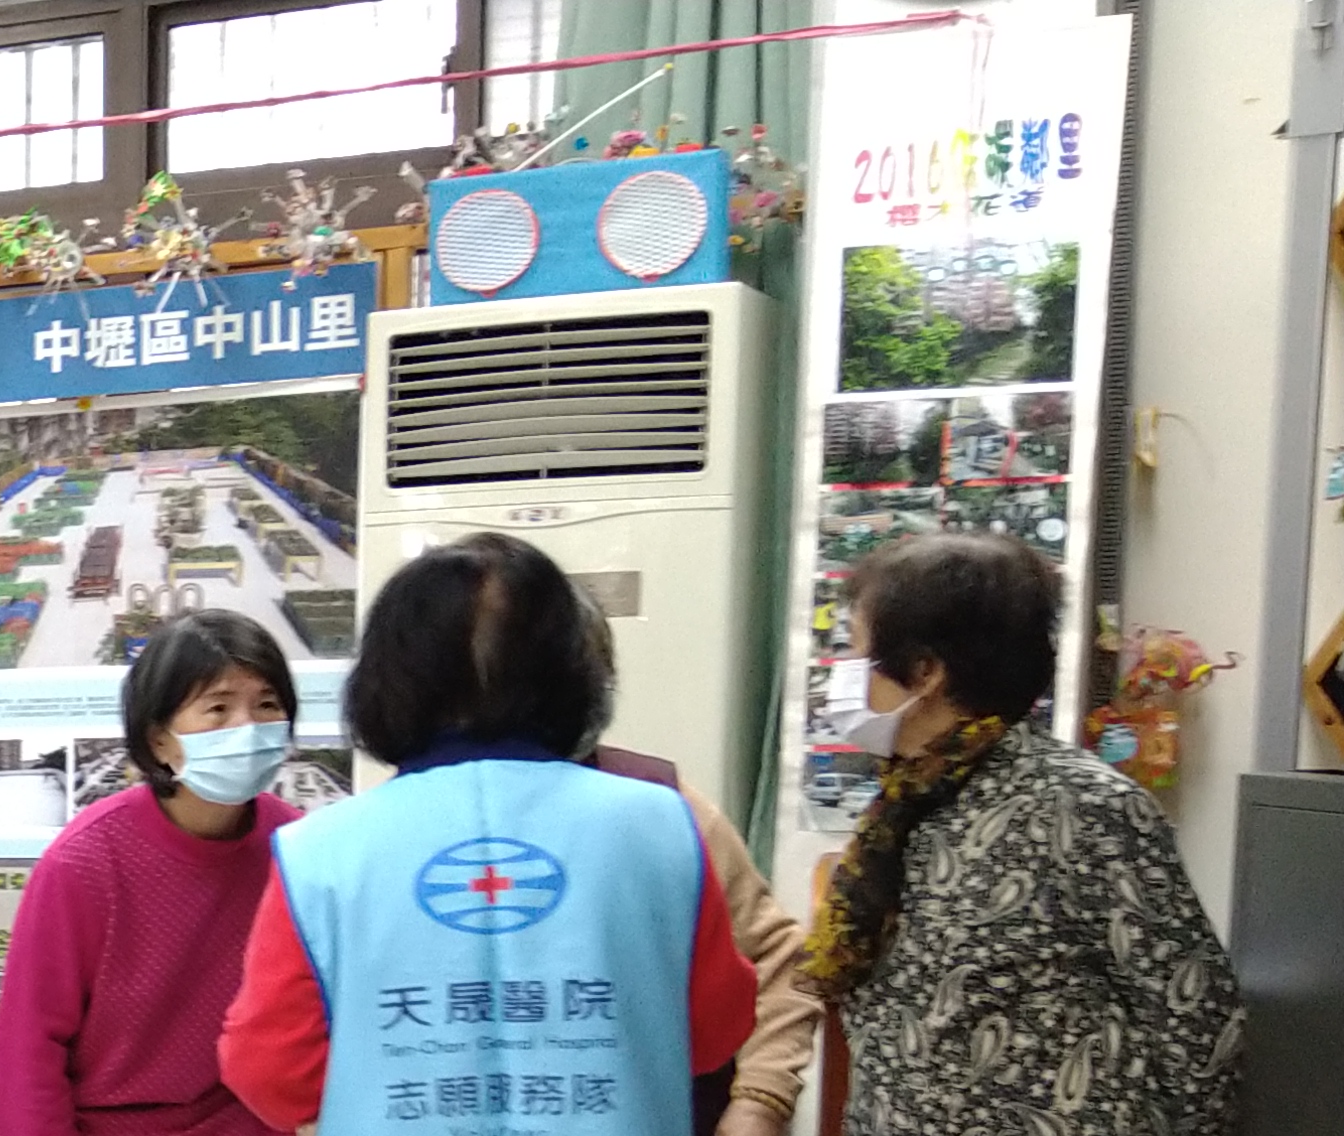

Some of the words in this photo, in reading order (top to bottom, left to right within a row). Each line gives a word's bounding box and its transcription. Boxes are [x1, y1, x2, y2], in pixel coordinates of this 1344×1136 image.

[34, 293, 360, 373] 中壢區中山里
[379, 980, 616, 1030] 天晟醫院
[385, 1074, 617, 1119] 志願服務隊
